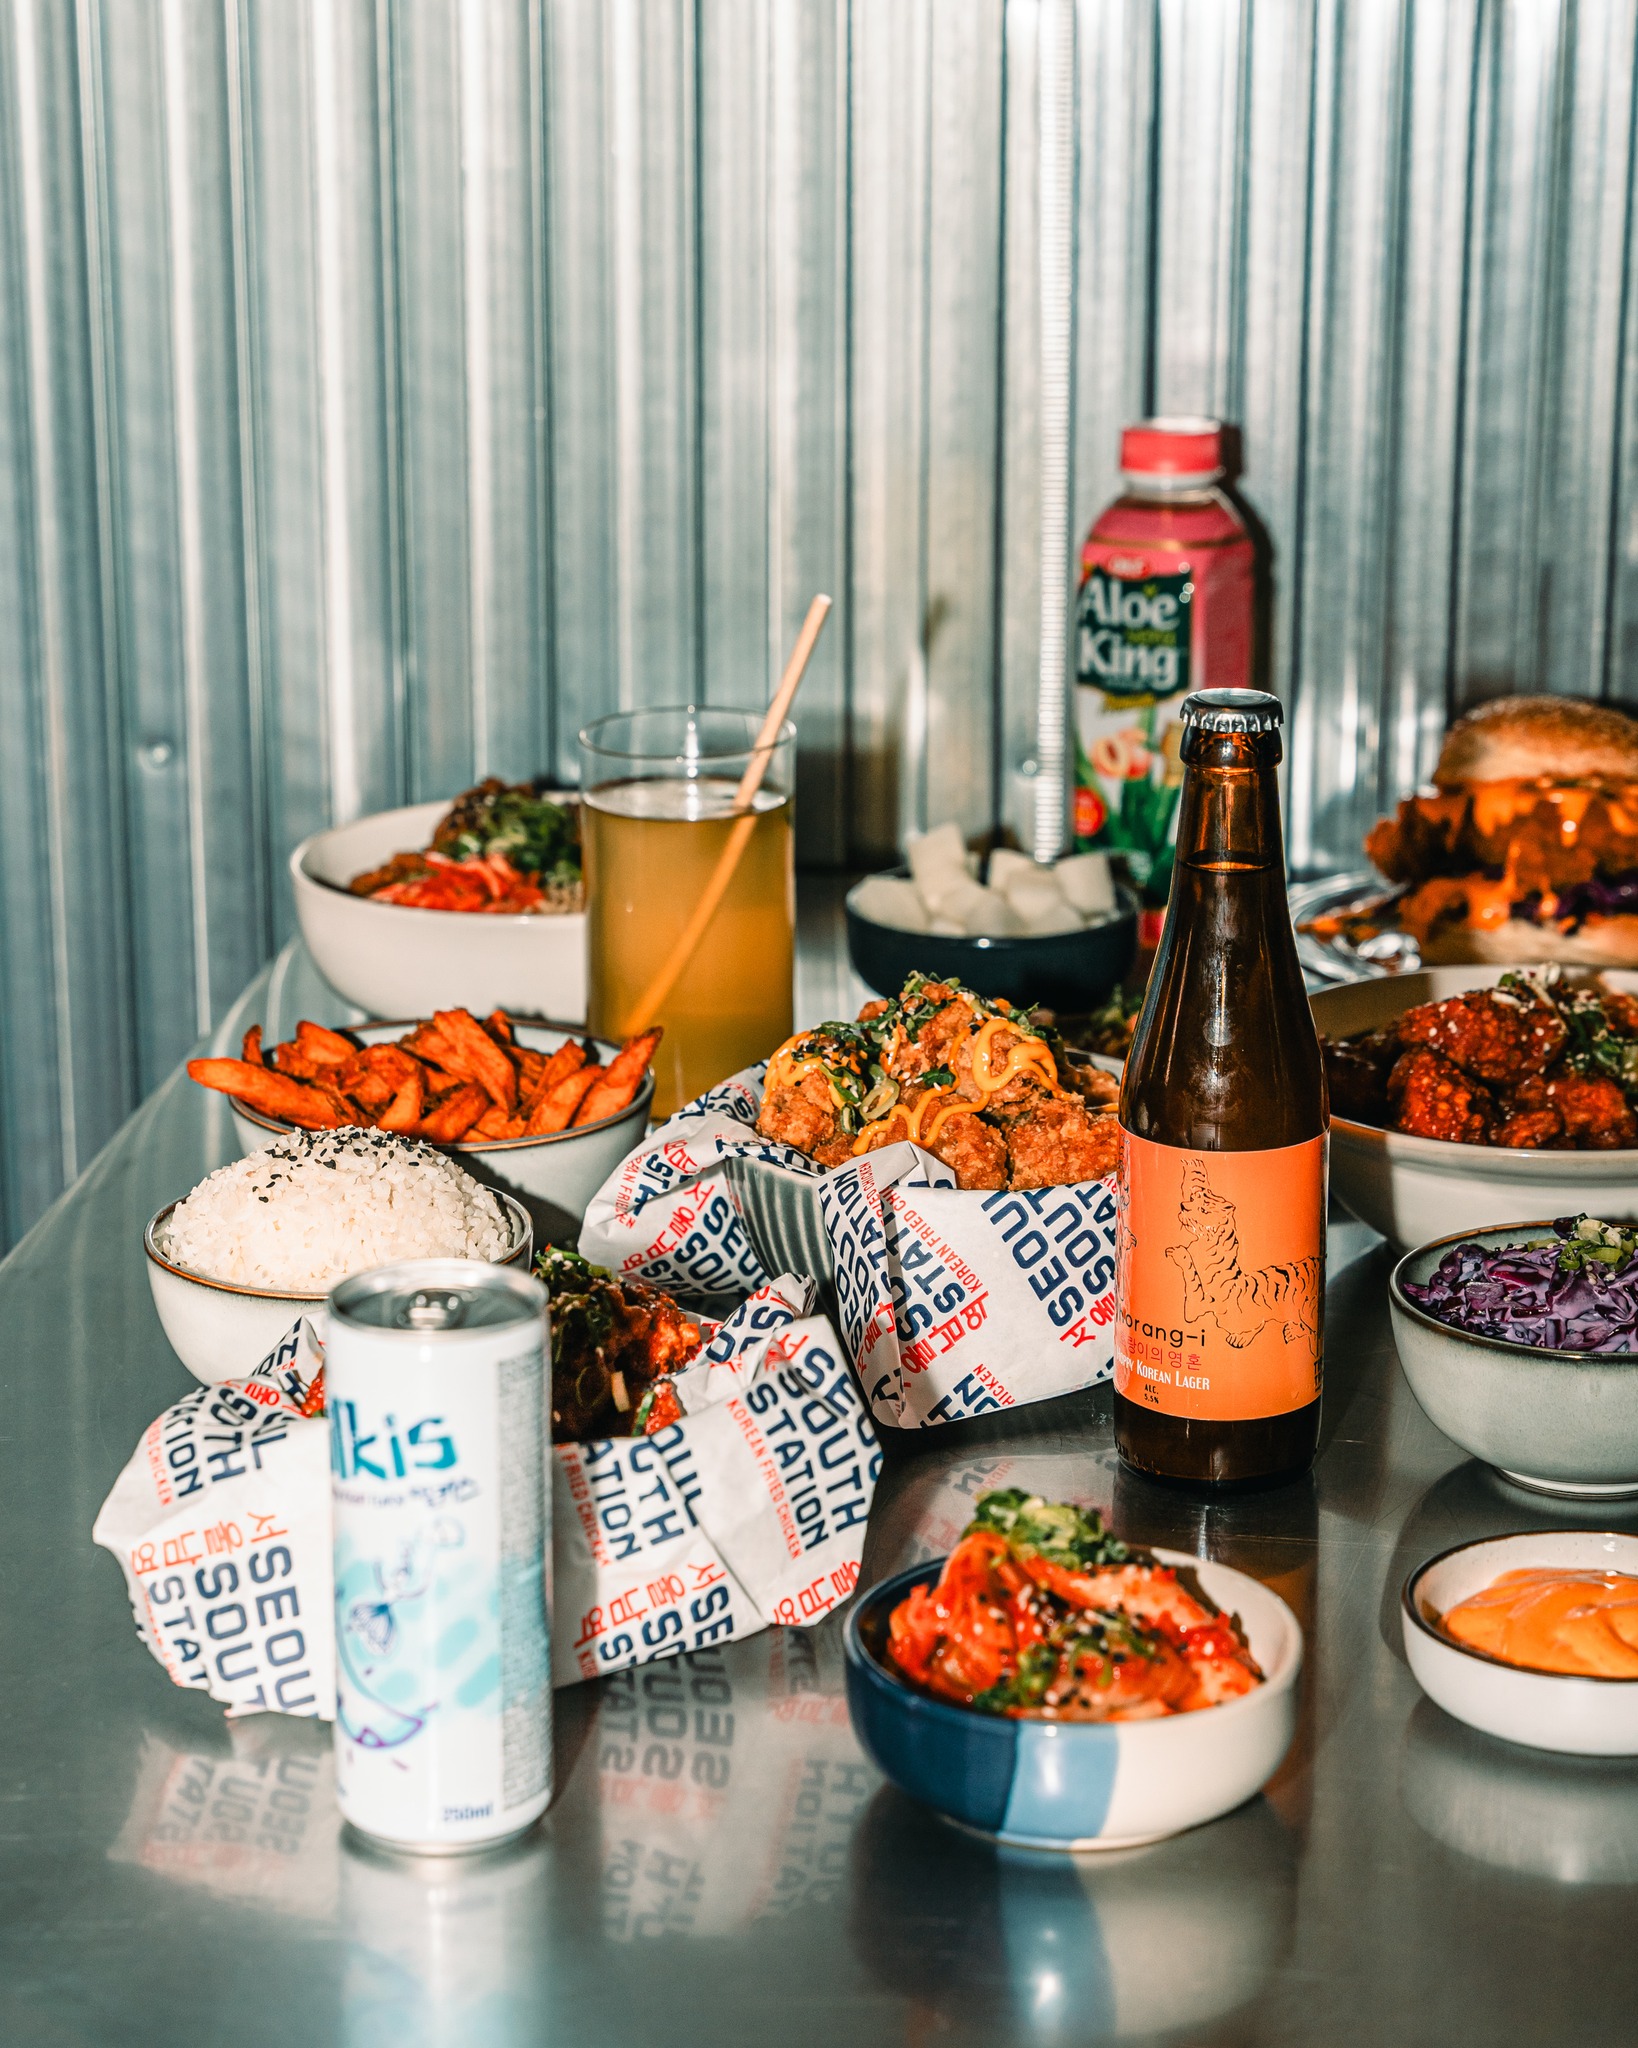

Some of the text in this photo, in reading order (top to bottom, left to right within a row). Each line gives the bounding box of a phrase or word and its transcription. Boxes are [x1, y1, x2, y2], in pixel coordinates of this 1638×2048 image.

[1081, 574, 1180, 631] Aloe
[1079, 626, 1180, 691] King
[903, 1209, 941, 1248] FRIED
[937, 1243, 984, 1294] KOREAN
[1144, 1393, 1160, 1405] 5.5%
[1175, 1370, 1211, 1391] LAGER
[331, 1397, 459, 1481] lkis
[745, 1382, 830, 1550] STATION
[726, 1398, 803, 1561] KOREAN FRIED CHICKEN
[249, 1545, 319, 1717] SEOU
